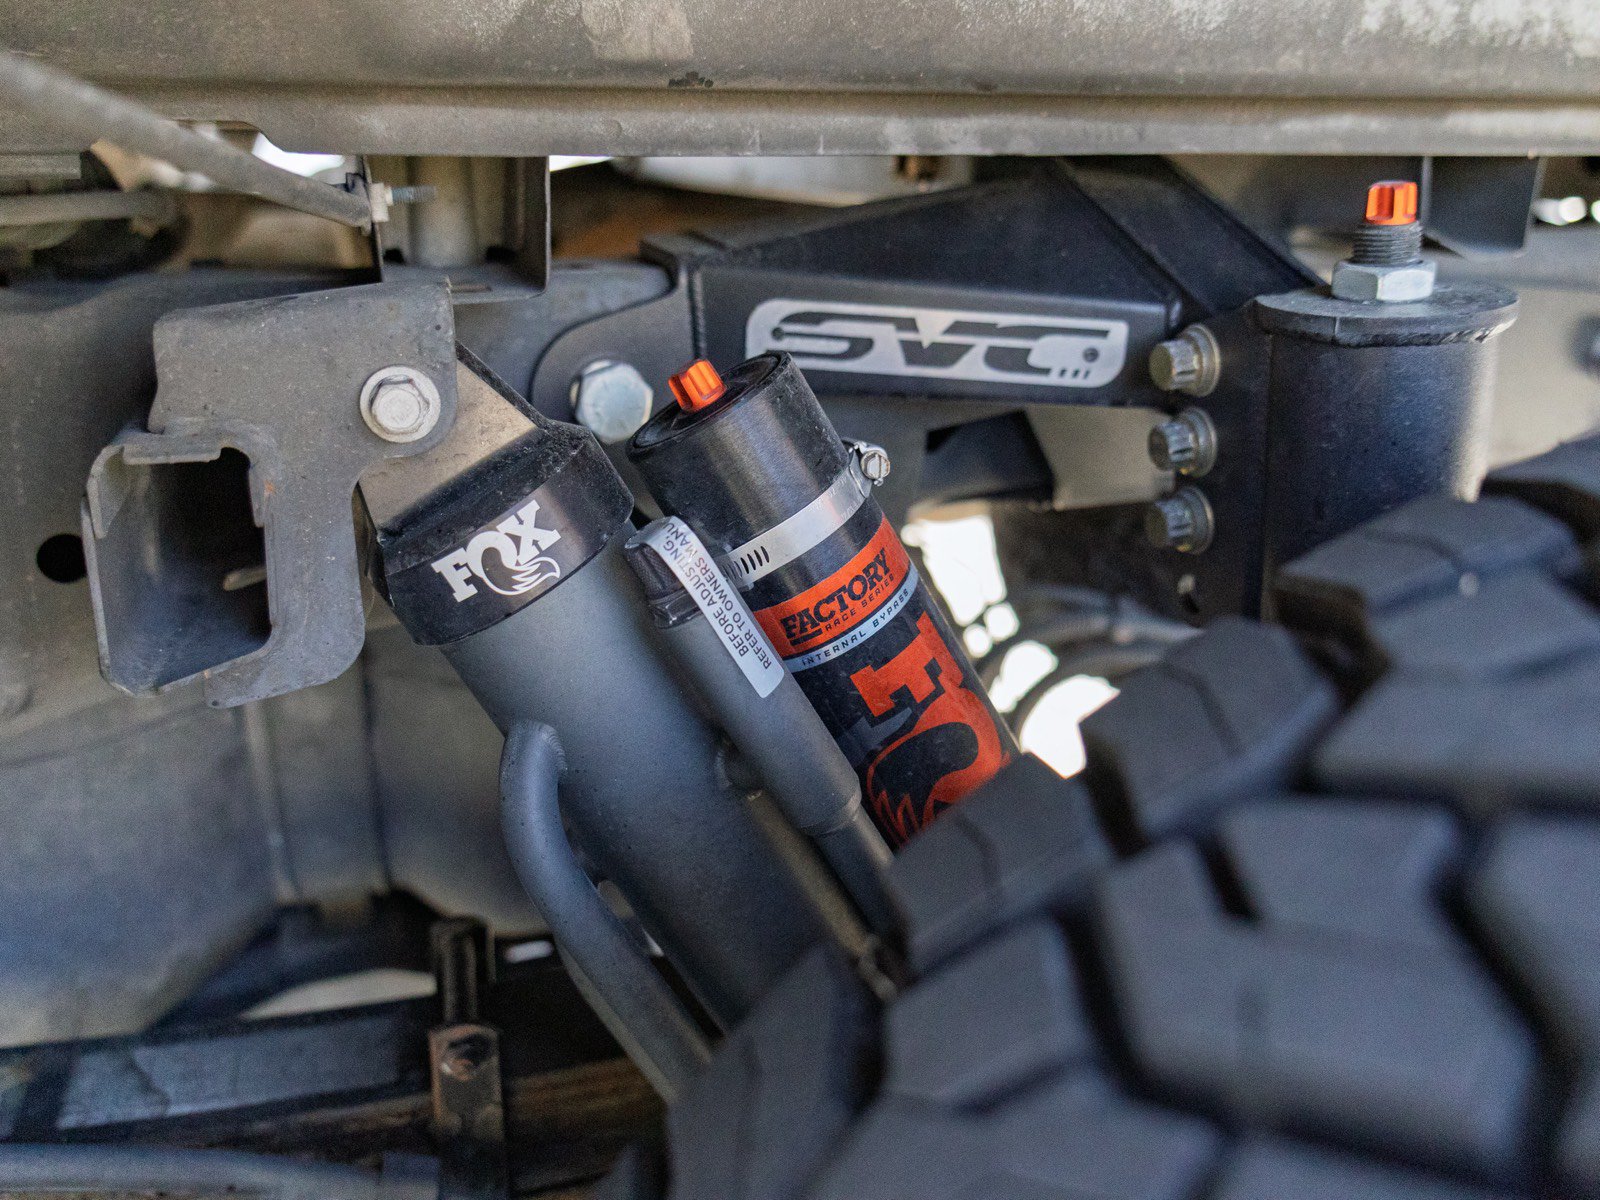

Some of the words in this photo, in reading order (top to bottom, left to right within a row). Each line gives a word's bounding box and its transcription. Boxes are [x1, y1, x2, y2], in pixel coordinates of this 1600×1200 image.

[771, 311, 1111, 376] SVC
[431, 499, 562, 603] FOX
[695, 557, 734, 612] OWNERS
[781, 547, 890, 639] FACTORY
[825, 608, 857, 631] RACE
[861, 573, 894, 608] SERIES
[713, 607, 749, 657] BEFORE
[733, 612, 748, 632] TO
[744, 628, 772, 670] REFER
[802, 630, 867, 666] INTERNAL
[872, 588, 909, 628] BYPASS
[850, 611, 1011, 848] FO
